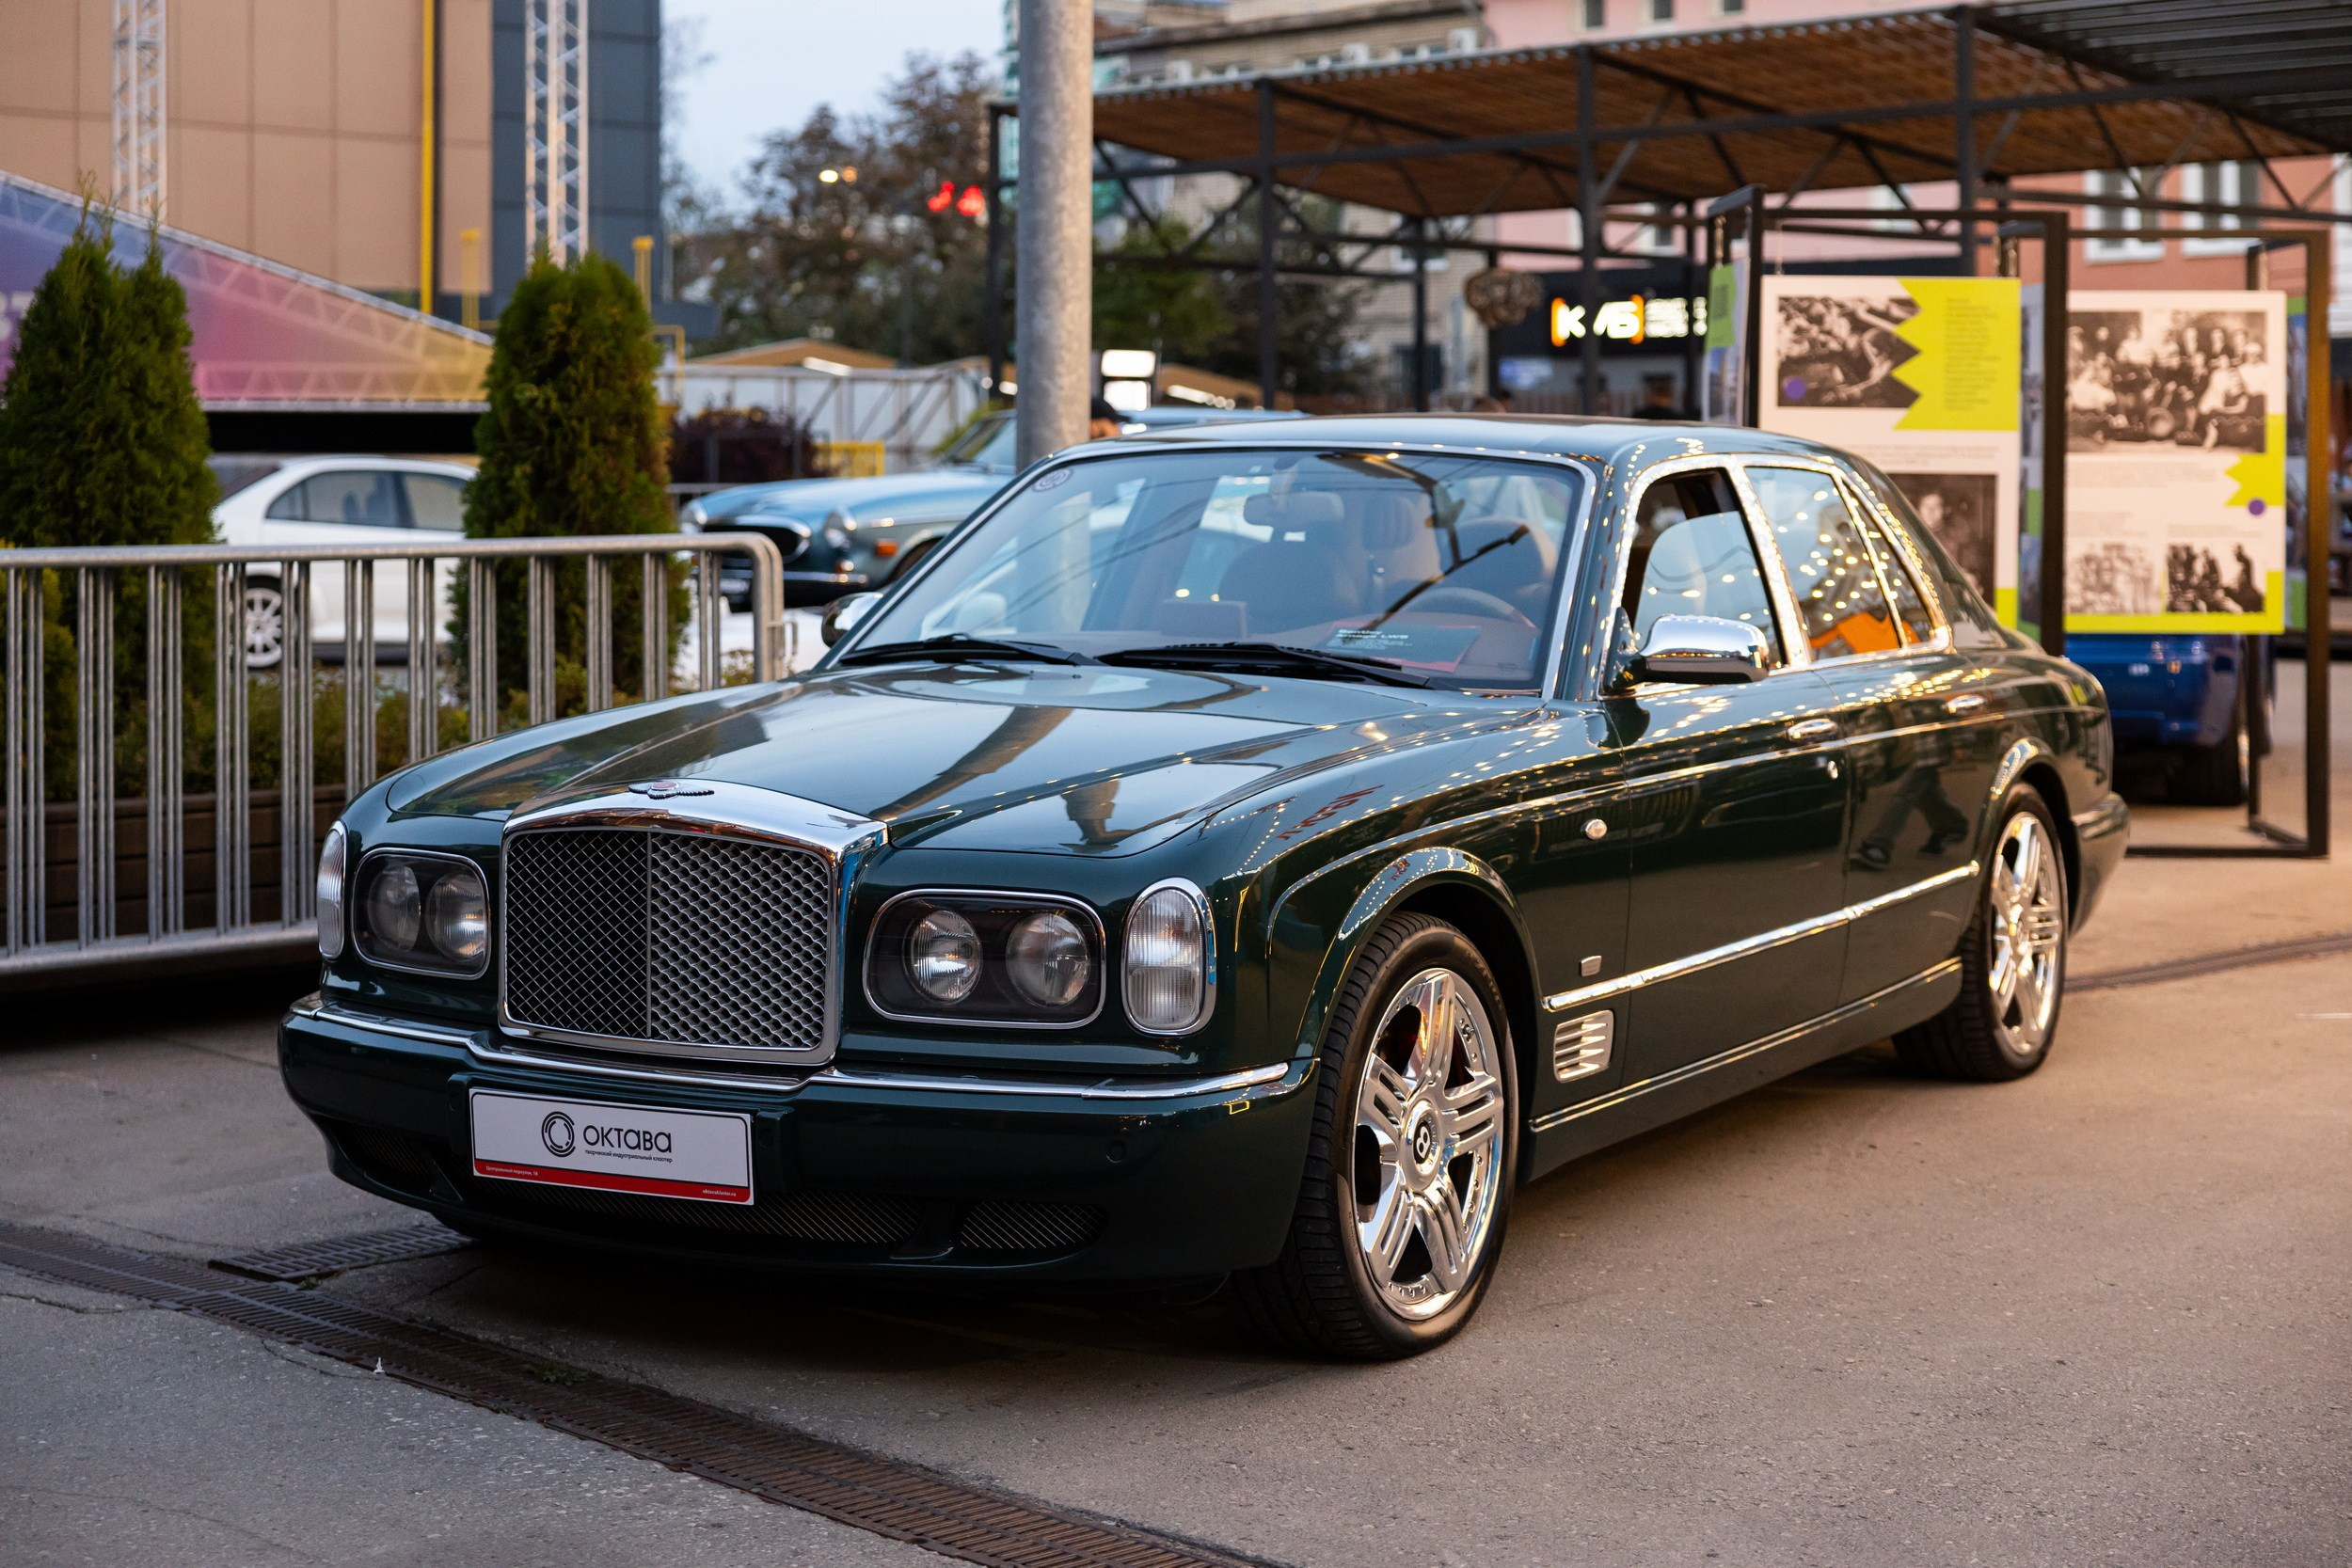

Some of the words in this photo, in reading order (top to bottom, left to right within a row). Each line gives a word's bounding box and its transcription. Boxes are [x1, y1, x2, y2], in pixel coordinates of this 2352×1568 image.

[584, 1148, 612, 1157] творческий
[612, 1151, 653, 1161] индустриальный
[653, 1156, 674, 1164] кластер
